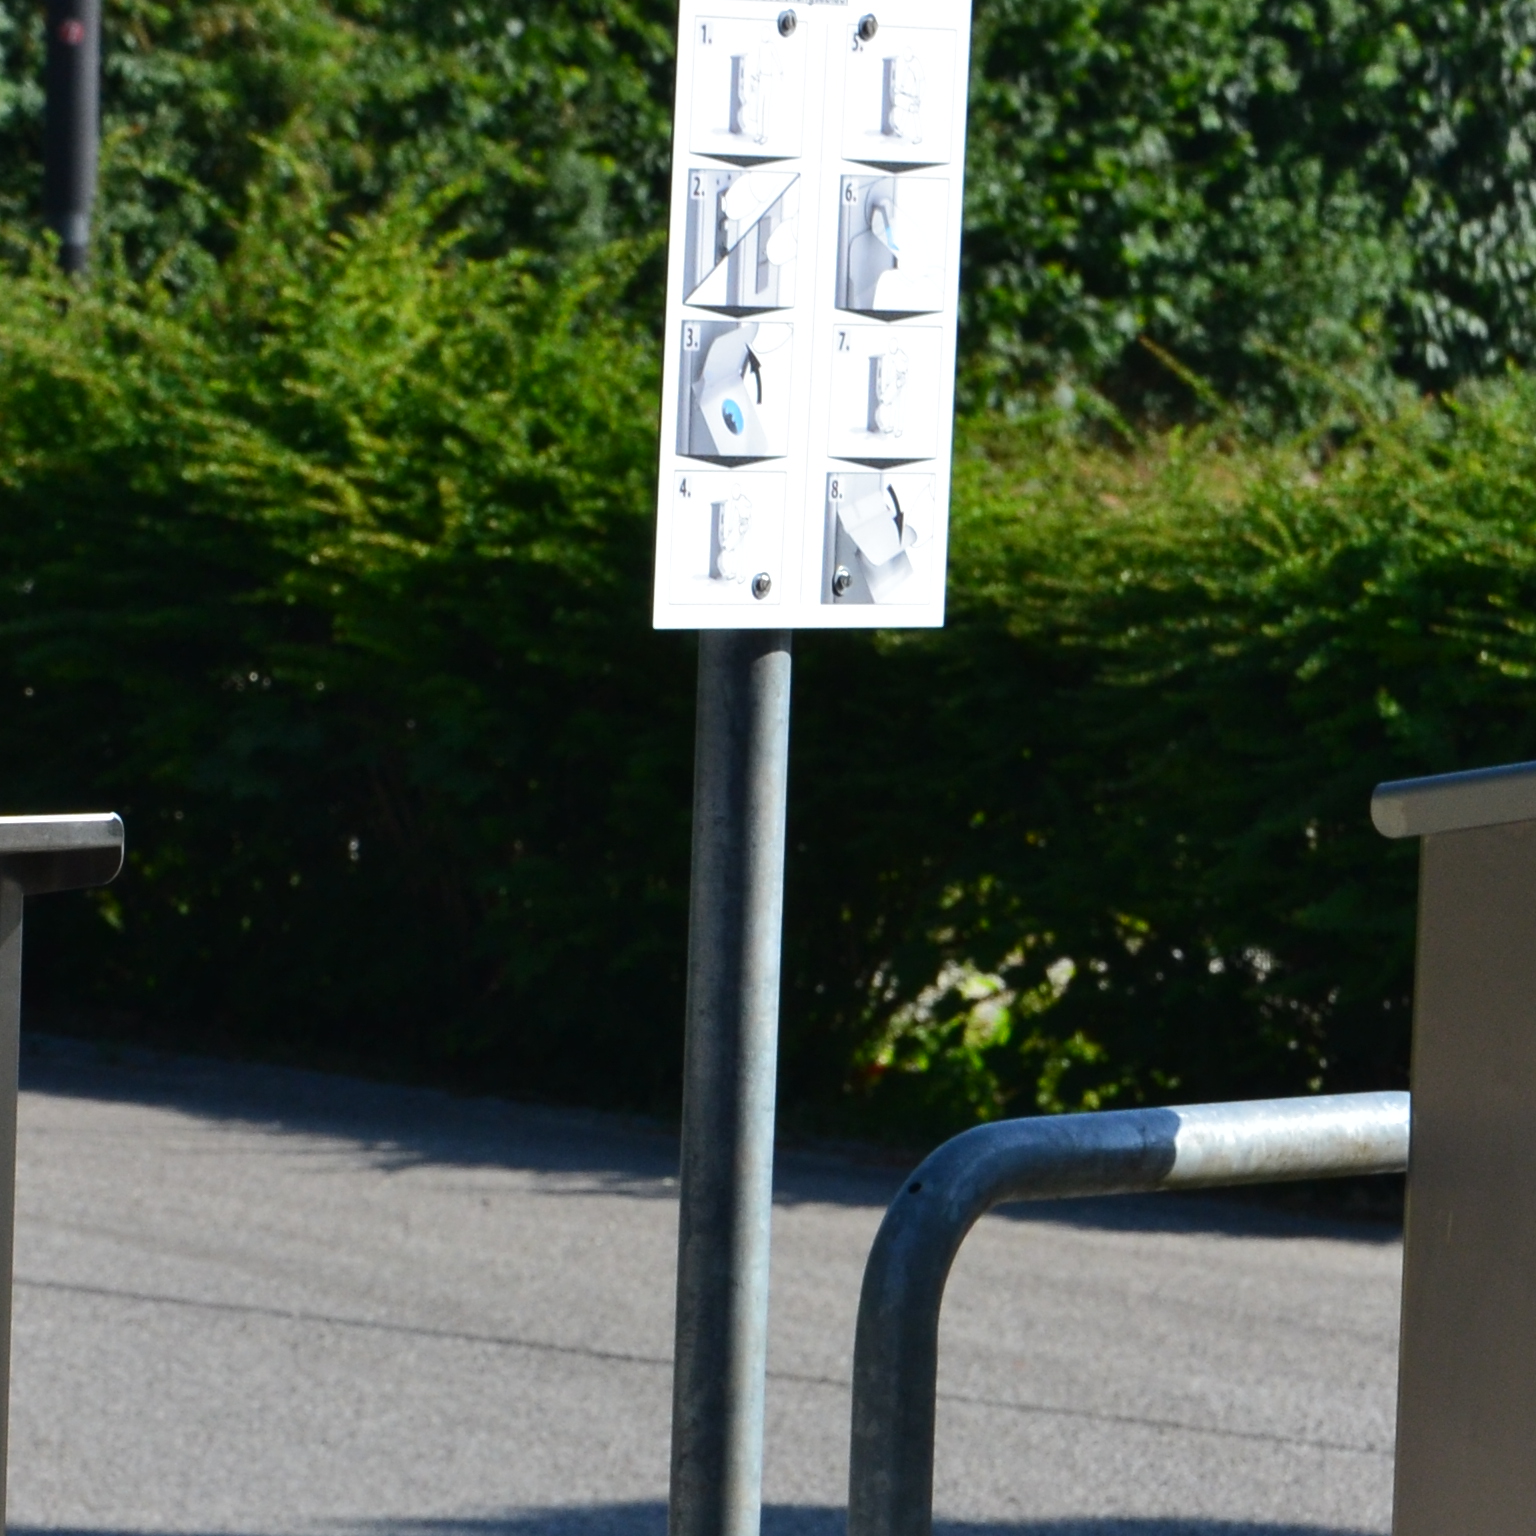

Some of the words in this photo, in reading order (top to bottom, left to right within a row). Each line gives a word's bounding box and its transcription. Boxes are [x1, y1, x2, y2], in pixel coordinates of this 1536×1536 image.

[700, 24, 712, 45] 1.
[693, 177, 705, 197] 2.
[845, 182, 857, 202] 6.
[686, 328, 699, 348] 3.
[838, 331, 850, 351] 7.
[679, 477, 691, 498] 4.
[831, 480, 843, 499] 8.
